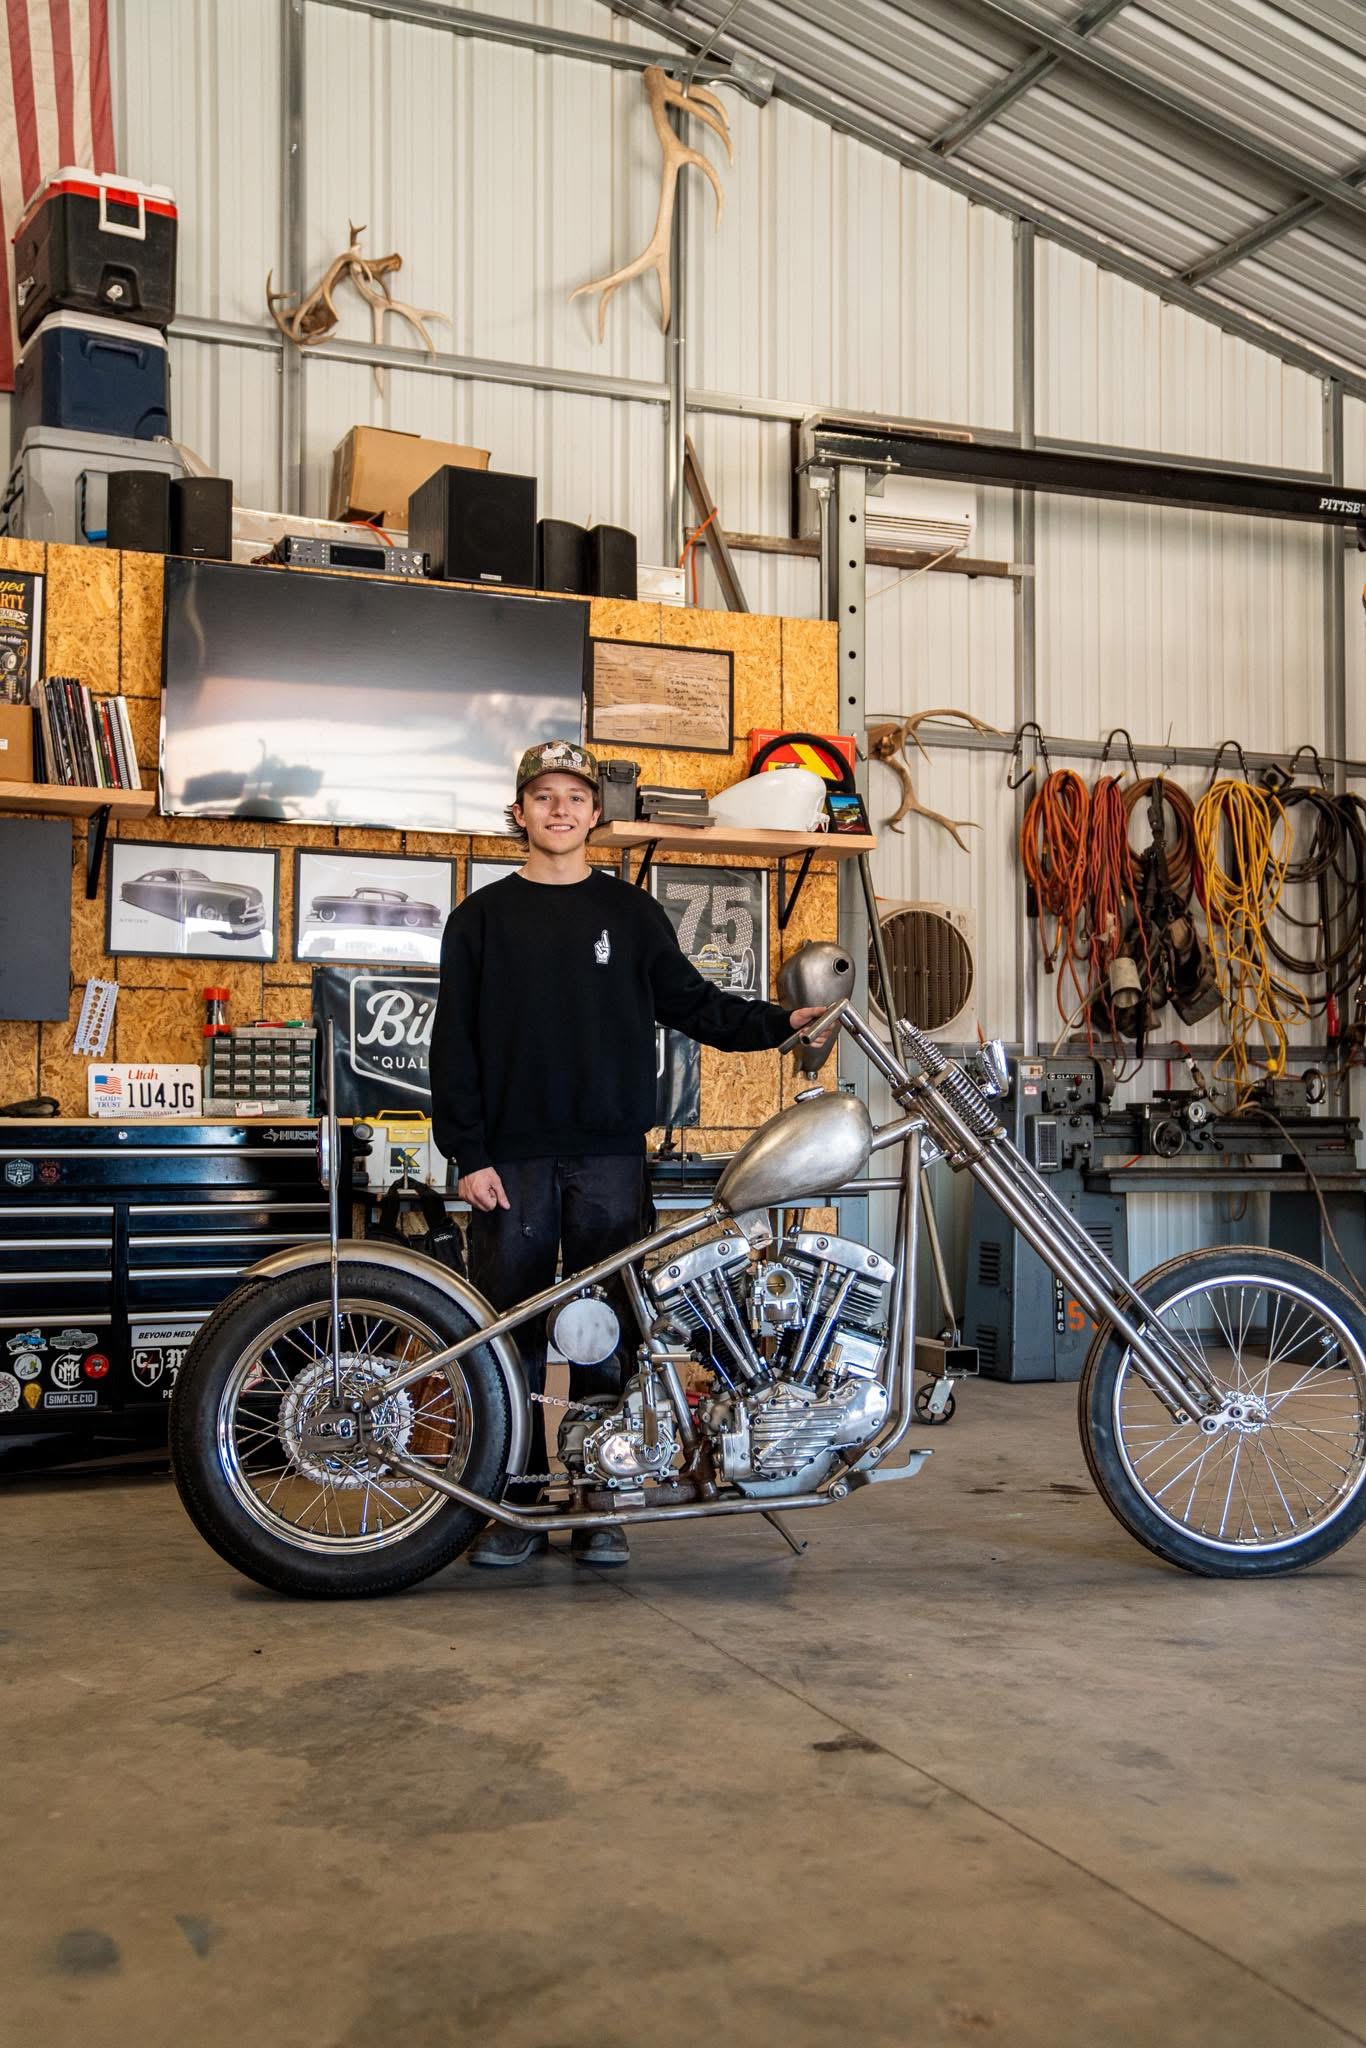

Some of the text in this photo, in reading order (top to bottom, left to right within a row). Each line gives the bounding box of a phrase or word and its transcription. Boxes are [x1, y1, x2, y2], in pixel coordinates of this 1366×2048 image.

[1319, 498, 1365, 514] PITTSB
[0, 594, 25, 610] RTY
[666, 883, 753, 957] 75
[128, 1069, 159, 1080] Utah
[128, 1082, 194, 1109] 1U4JG
